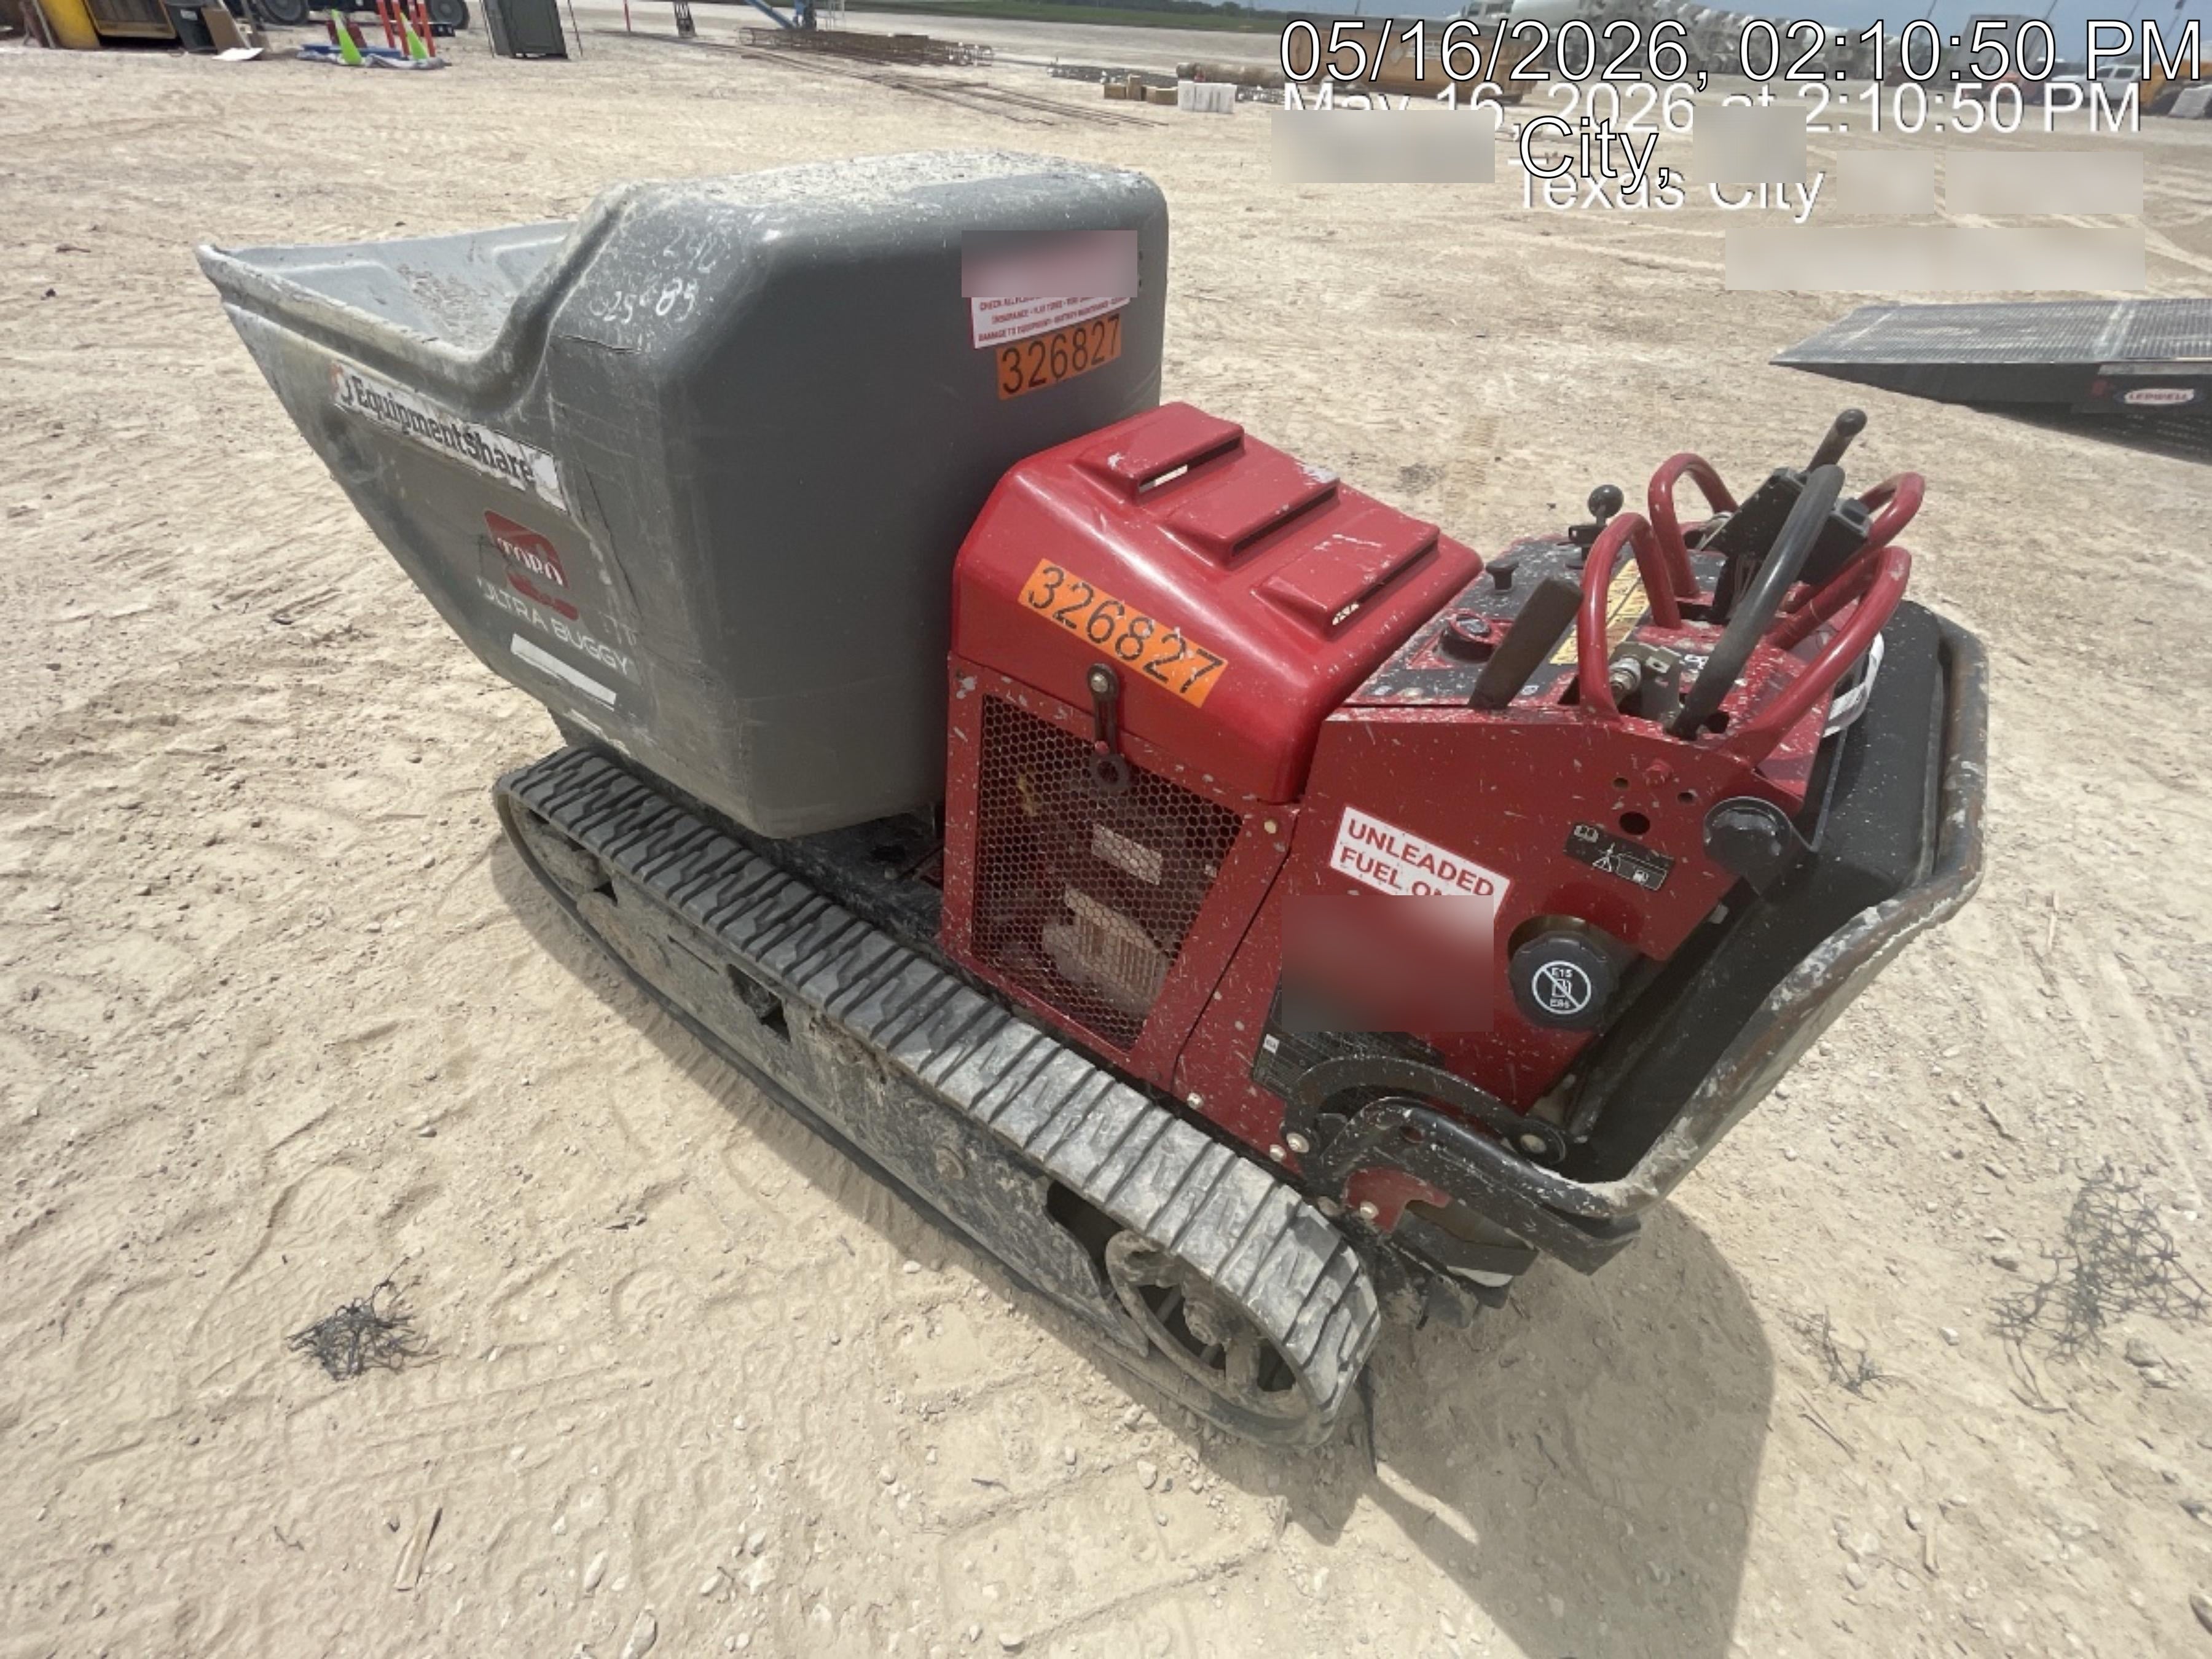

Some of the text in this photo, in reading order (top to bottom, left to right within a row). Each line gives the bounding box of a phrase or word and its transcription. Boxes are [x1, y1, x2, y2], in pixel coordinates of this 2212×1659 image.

[1002, 313, 1120, 394] 326827
[351, 375, 535, 483] EquipmentShare
[551, 617, 628, 675] BUGGY
[1027, 565, 1223, 693] 326827
[1340, 846, 1402, 890] FUEL
[1348, 818, 1494, 895] UNLEADED
